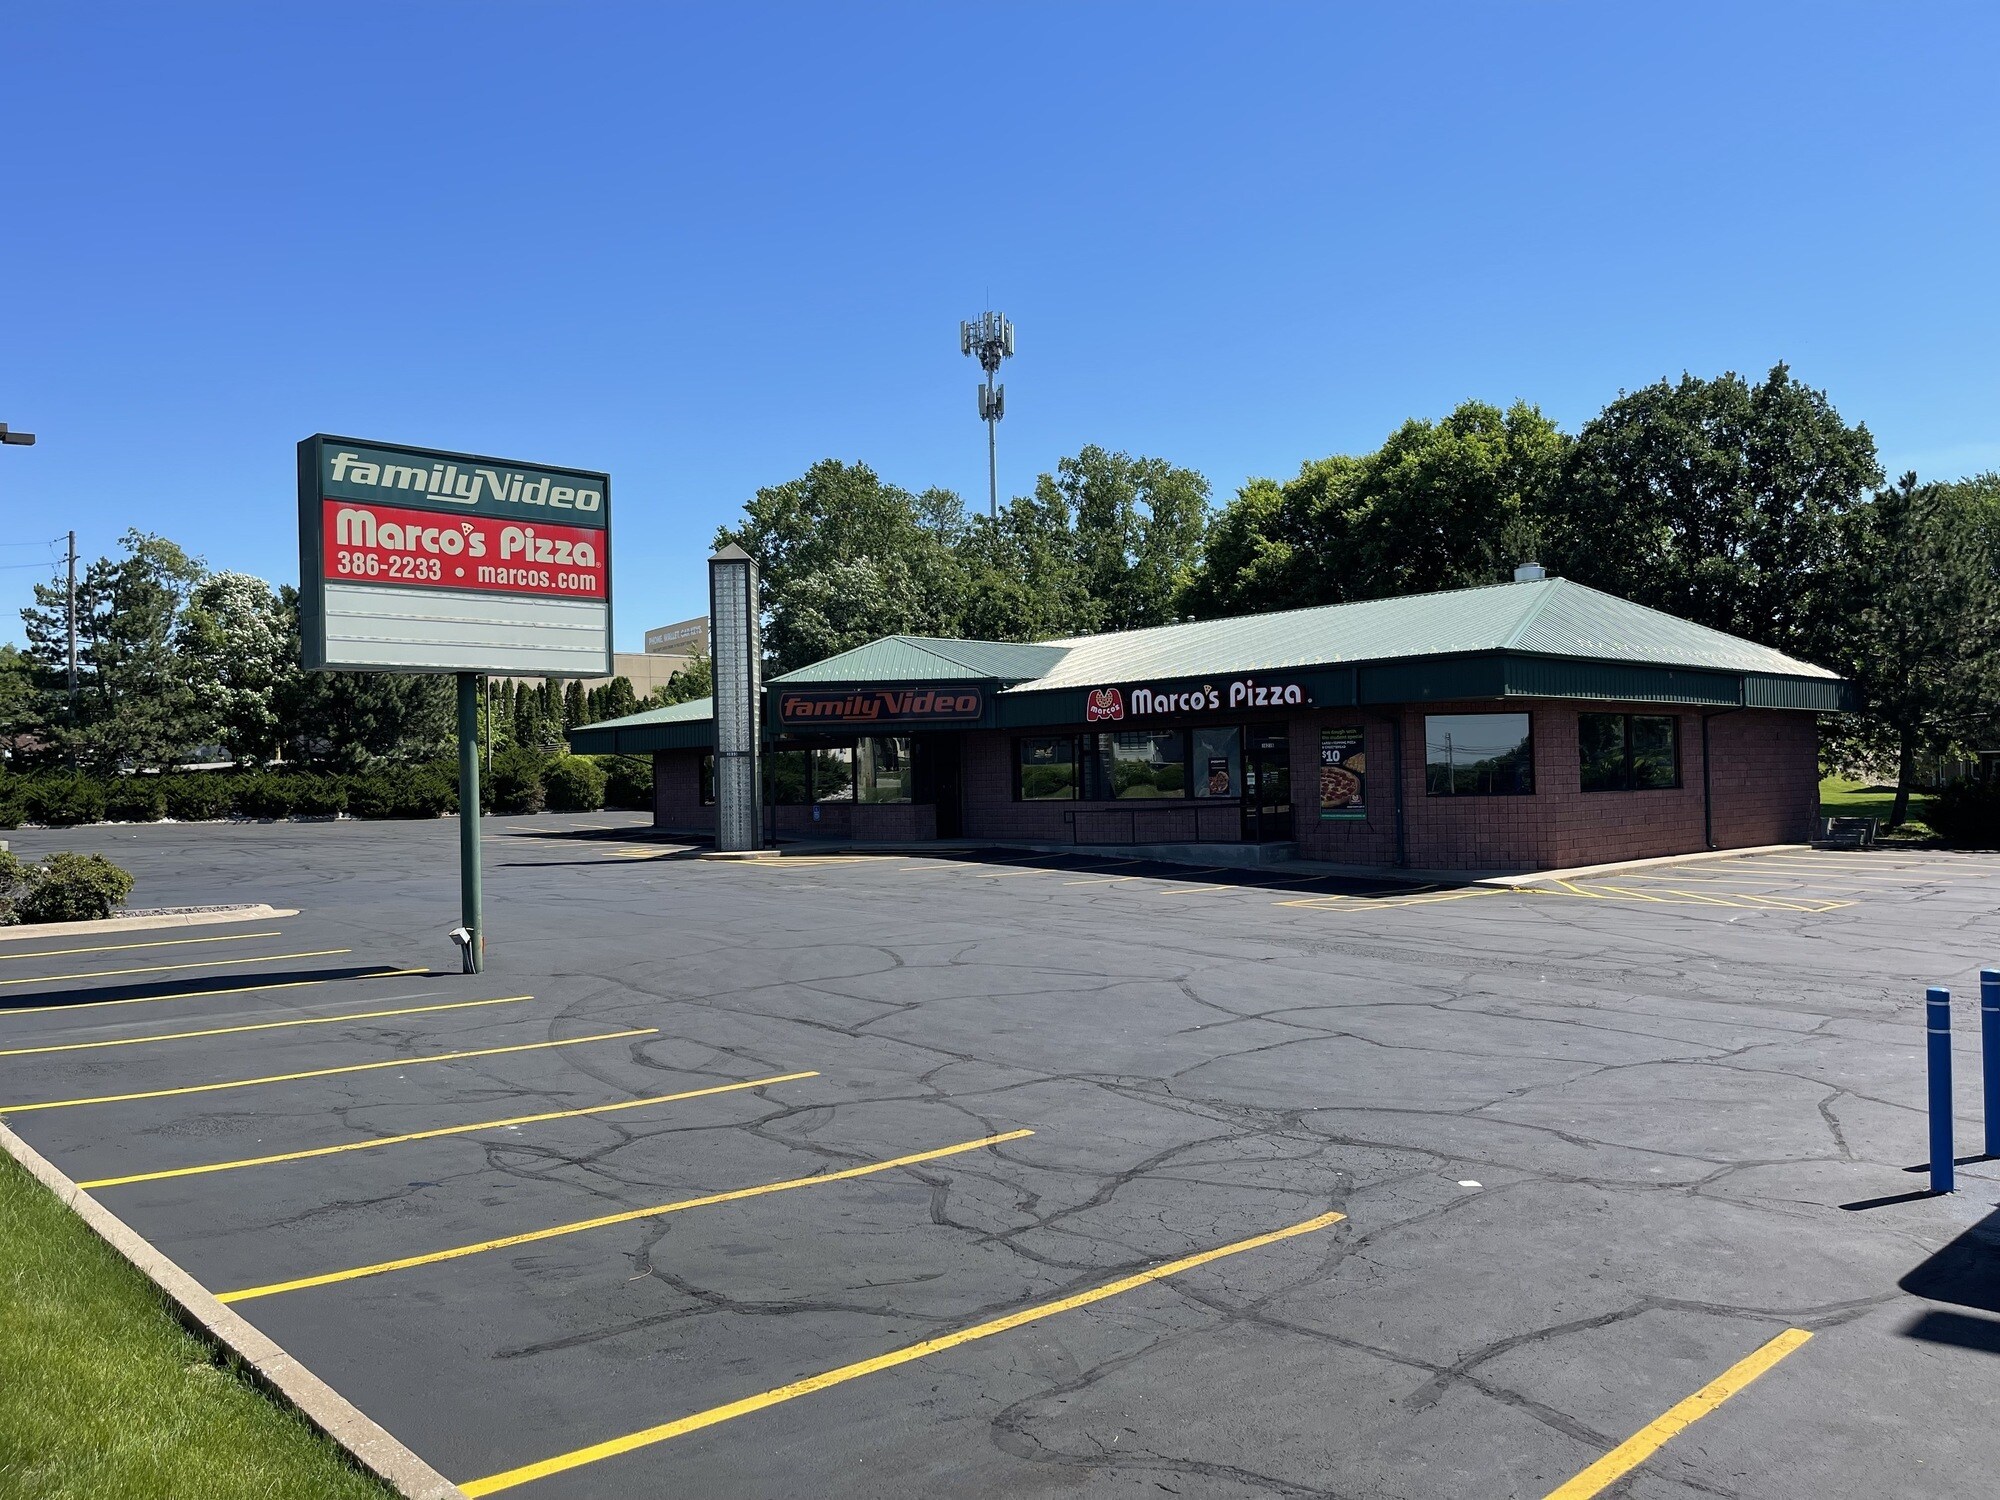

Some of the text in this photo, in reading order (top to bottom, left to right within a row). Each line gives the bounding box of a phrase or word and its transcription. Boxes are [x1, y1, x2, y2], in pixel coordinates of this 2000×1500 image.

[336, 508, 596, 568] Marco's Pizza
[337, 551, 597, 591] 386-2233 marcos.com
[1131, 679, 1302, 715] Marco's Pizza
[1322, 750, 1340, 762] $10
